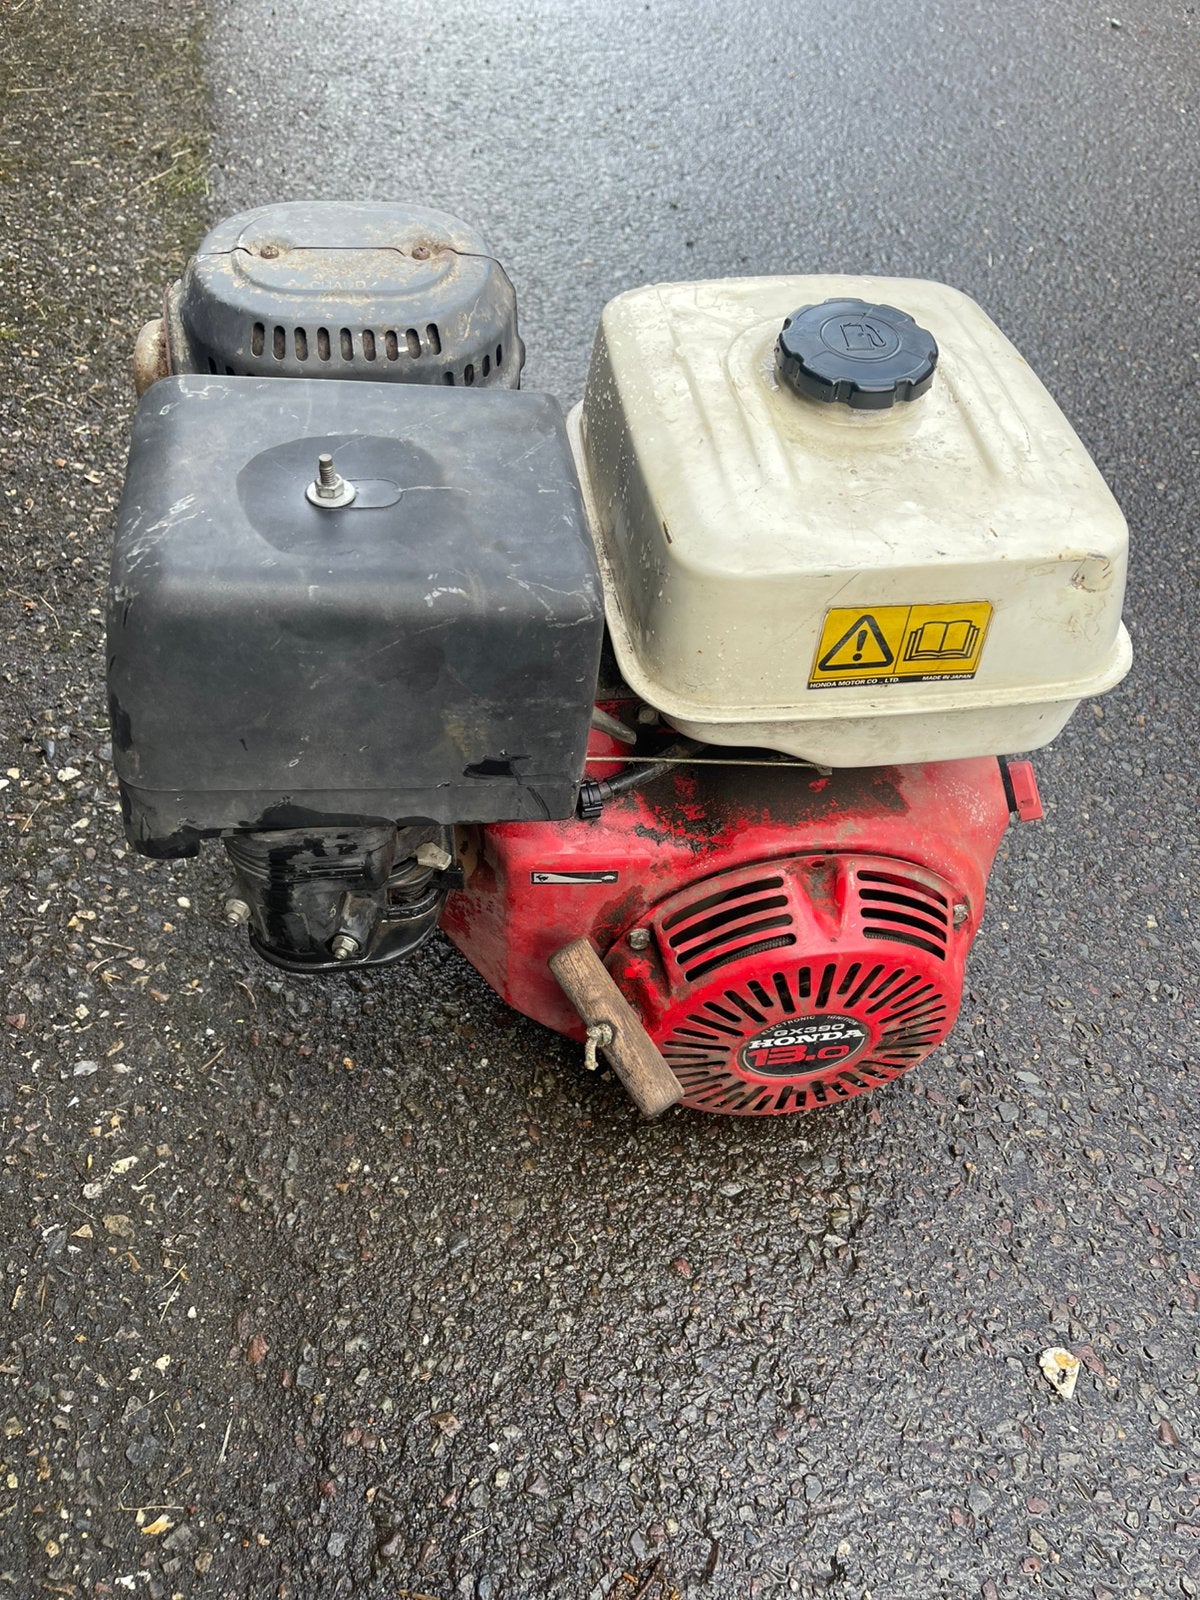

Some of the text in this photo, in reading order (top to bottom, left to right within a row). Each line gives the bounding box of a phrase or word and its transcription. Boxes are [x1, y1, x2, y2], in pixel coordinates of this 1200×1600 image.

[761, 1015, 816, 1035] ELECTRONIC
[774, 1023, 845, 1037] GX390
[748, 1029, 865, 1049] HONDA
[748, 1045, 850, 1066] 13.0
